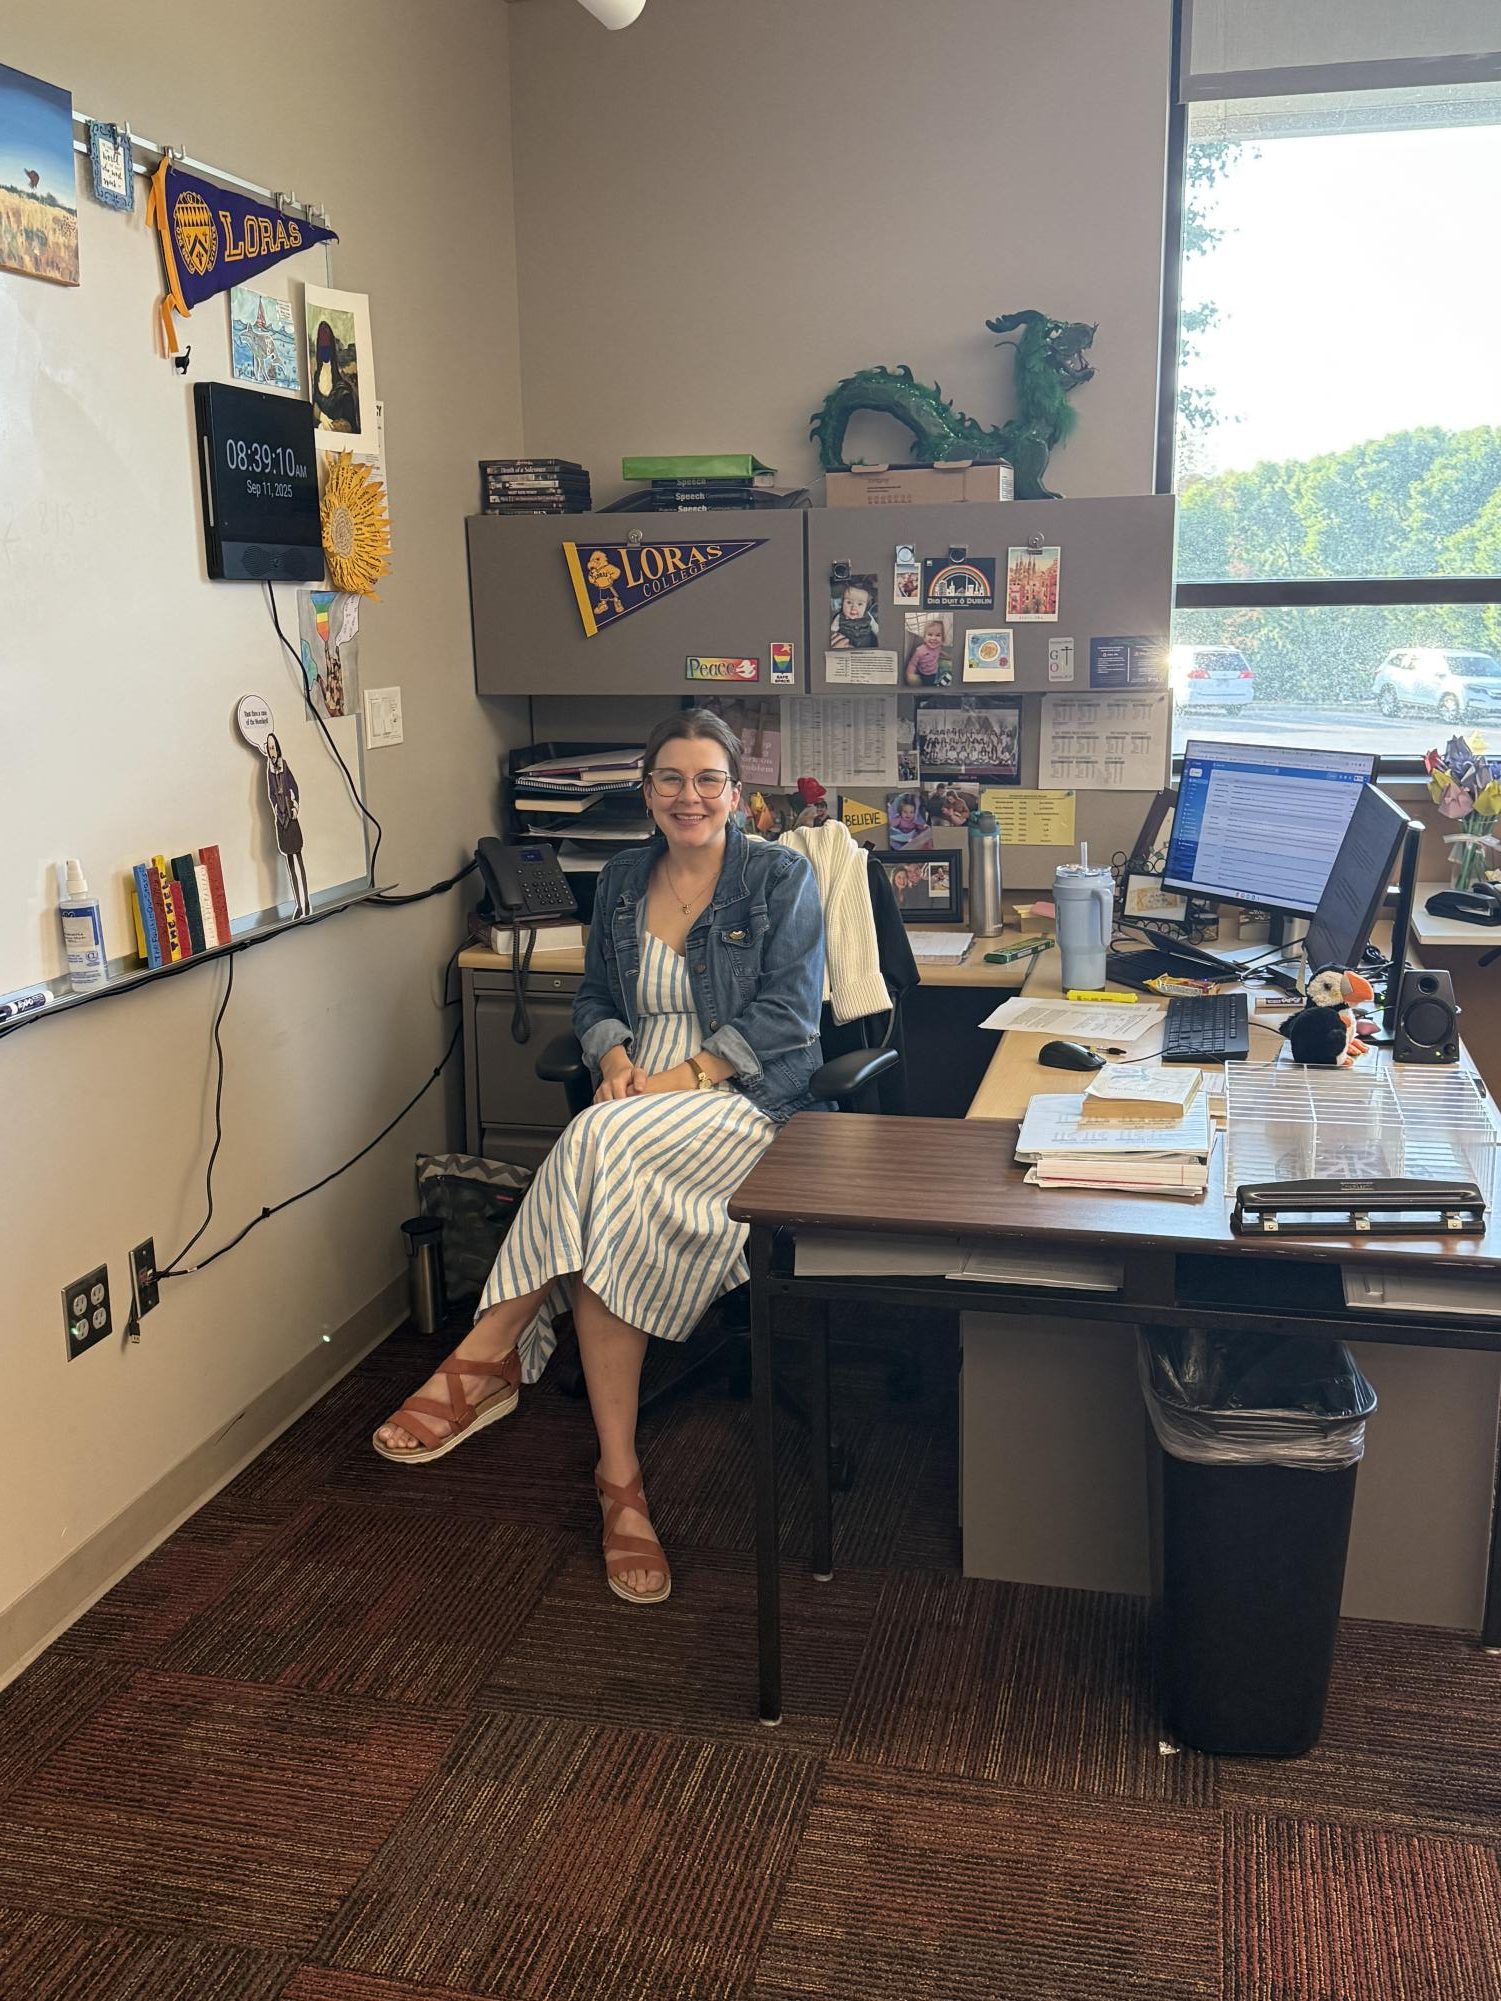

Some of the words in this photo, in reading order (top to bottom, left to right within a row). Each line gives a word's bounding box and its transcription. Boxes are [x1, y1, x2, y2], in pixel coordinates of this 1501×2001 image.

[218, 211, 303, 262] LORAS
[227, 439, 295, 477] 08:39:10
[246, 480, 261, 498] Sep
[262, 482, 274, 498] 11,
[275, 483, 293, 498] 2025
[676, 492, 705, 502] Speech
[617, 545, 723, 588] LORAS
[643, 562, 707, 597] COLLEGE
[688, 658, 735, 677] Peace
[844, 812, 881, 827] BELIEVE
[160, 872, 173, 914] HELP
[168, 921, 179, 951] THE
